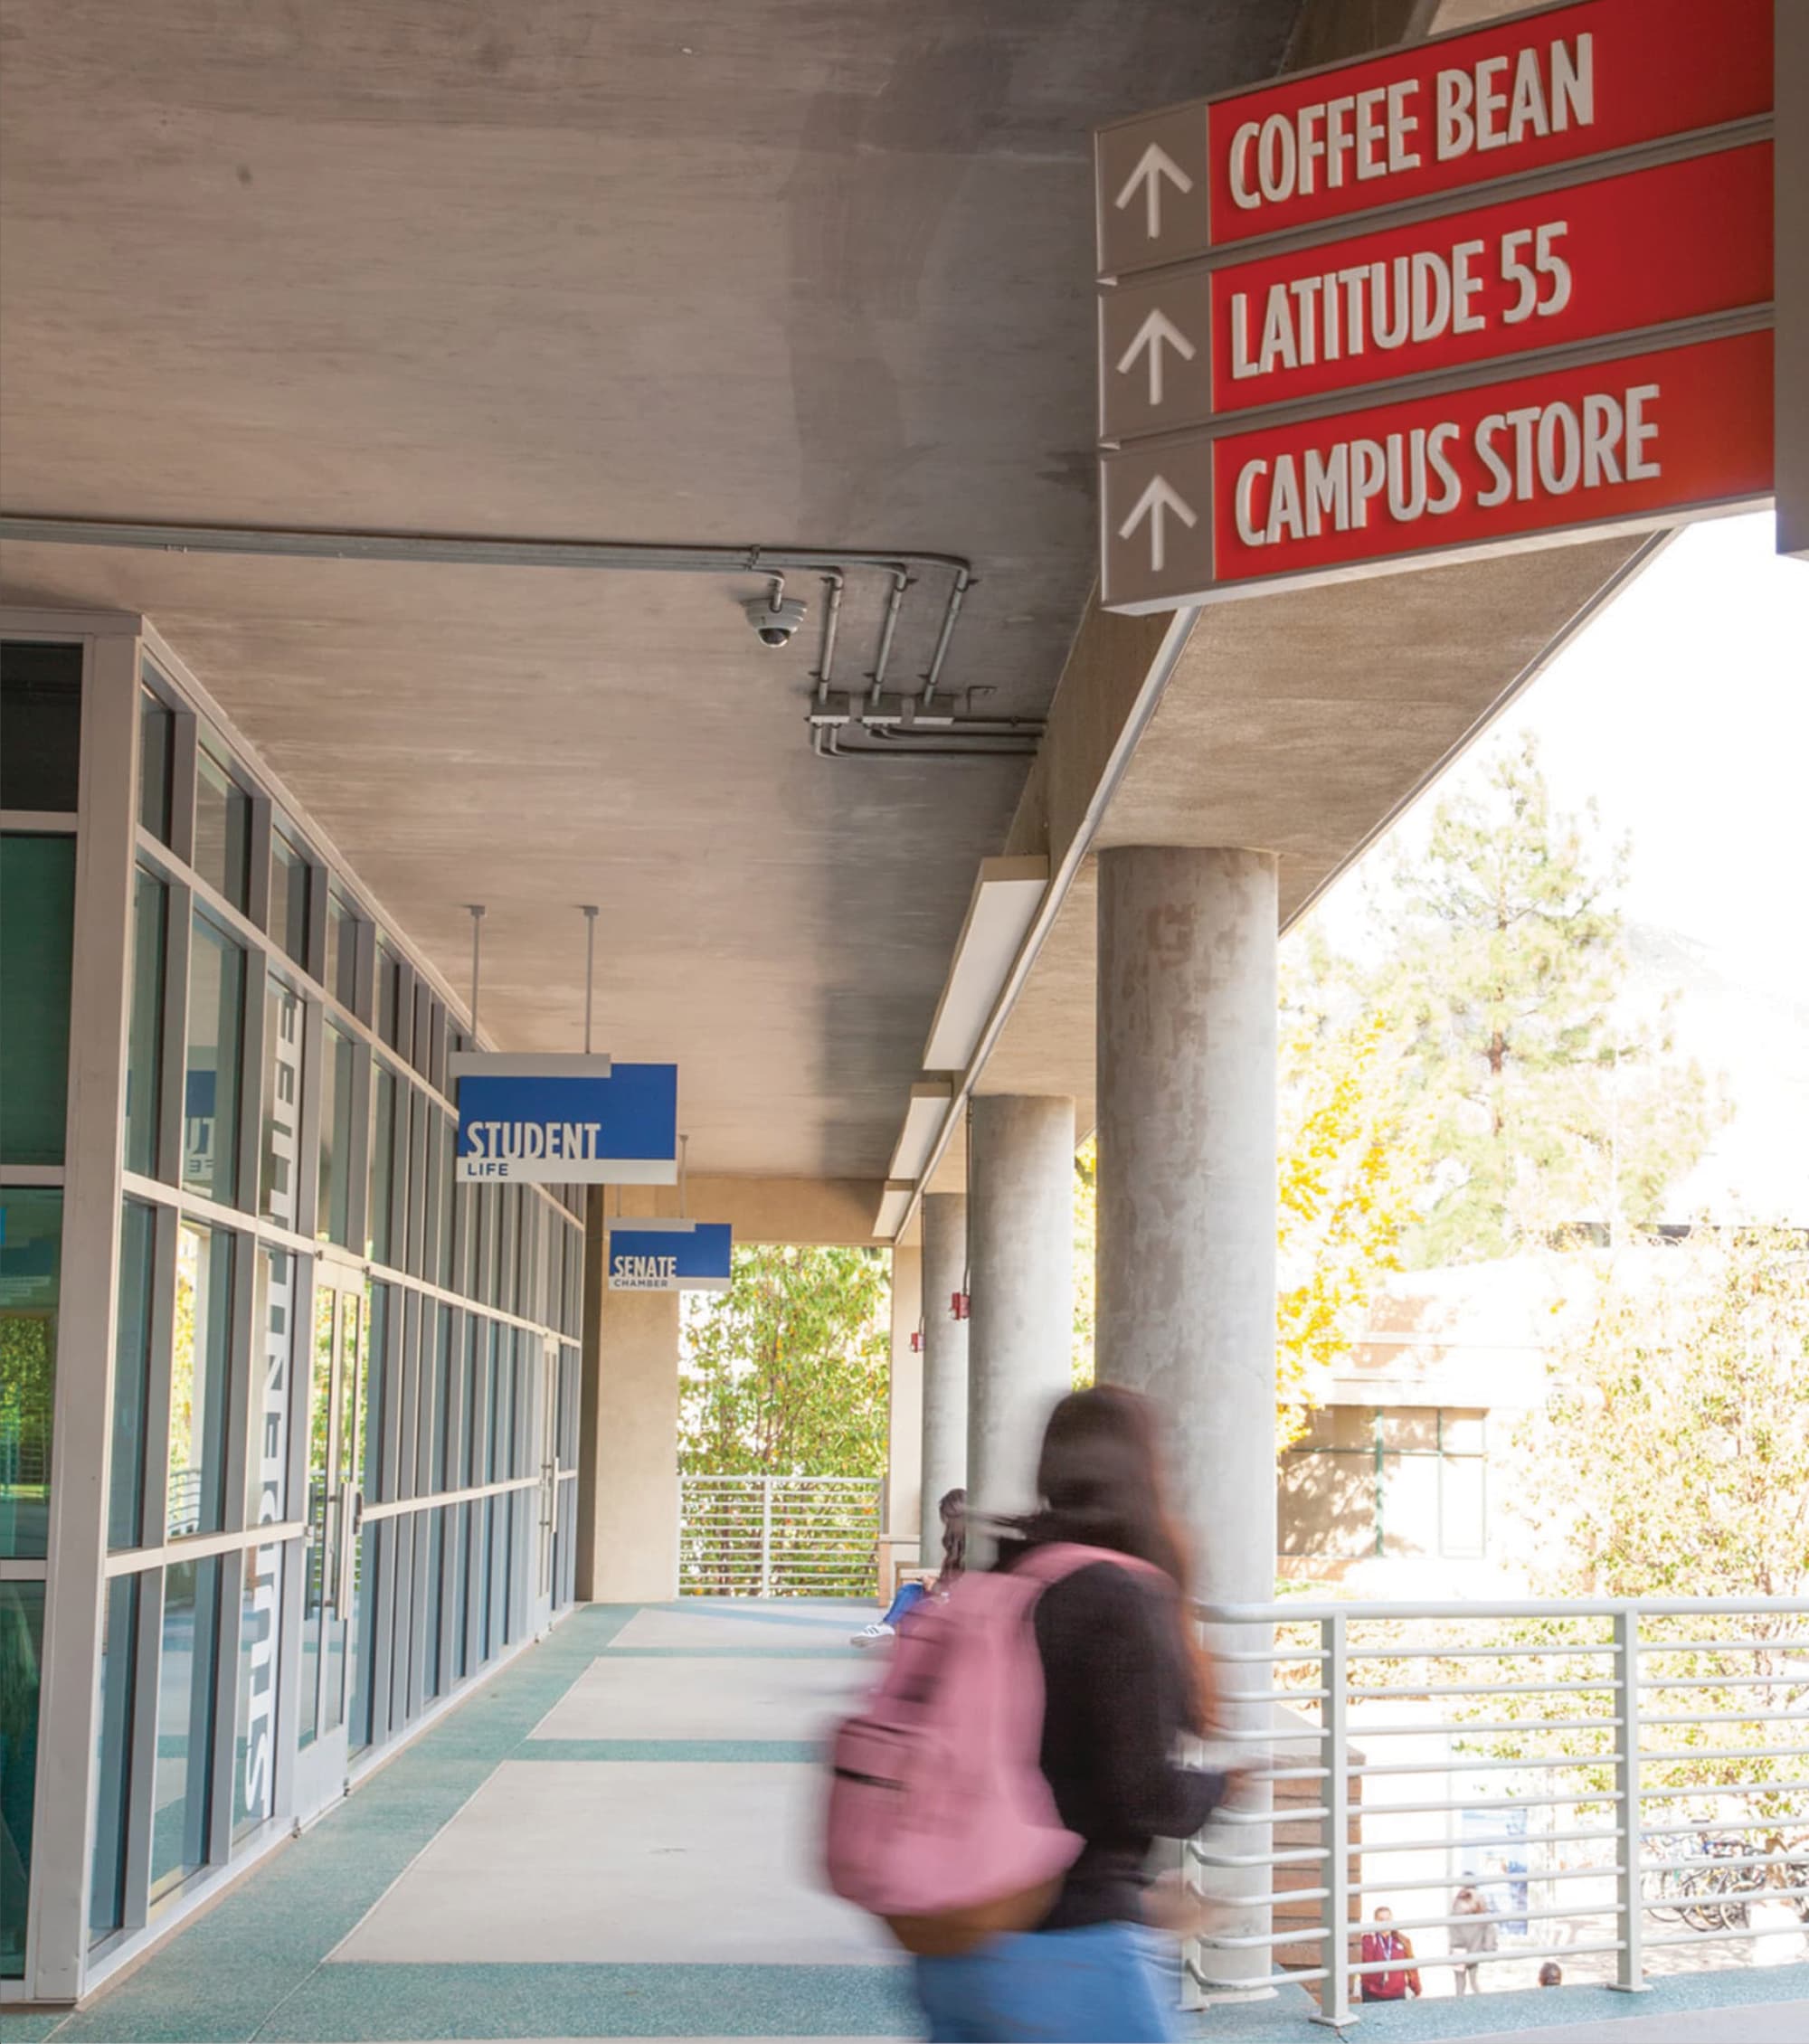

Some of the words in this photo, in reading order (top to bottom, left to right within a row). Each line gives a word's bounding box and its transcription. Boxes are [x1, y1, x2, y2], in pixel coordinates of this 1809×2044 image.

[1229, 80, 1420, 209] COFFEE
[1436, 33, 1594, 161] BEAN
[1232, 240, 1485, 379] LATITUDE
[1501, 222, 1572, 323] 55
[1236, 423, 1461, 546] CAMPUS
[1475, 384, 1661, 506] STORE
[467, 1121, 601, 1159] STUDENT
[468, 1163, 509, 1176] LIFE
[614, 1256, 677, 1278] SENATE
[245, 1251, 291, 1812] STUDENT
[270, 993, 301, 1216] LIFE
